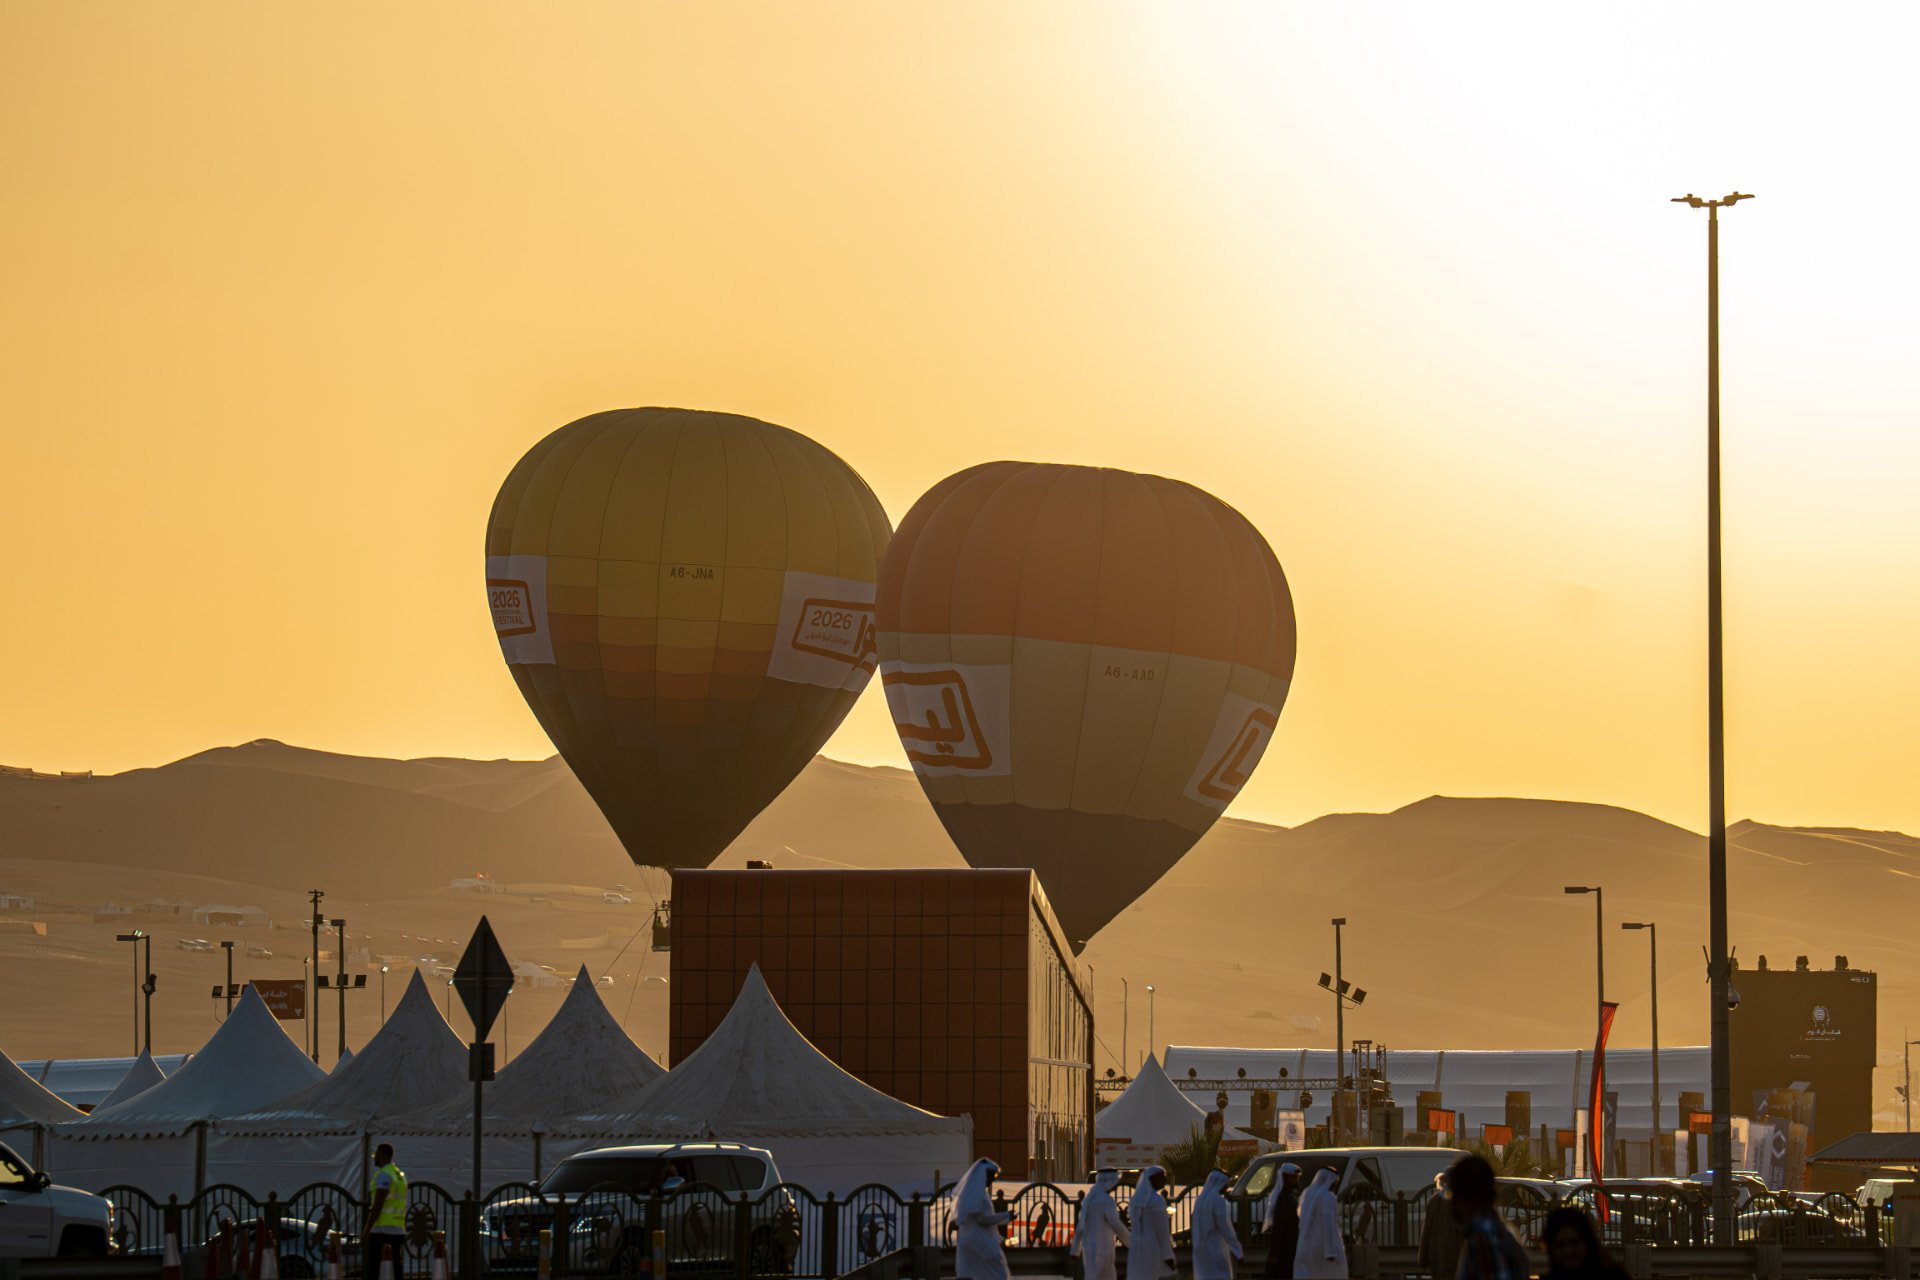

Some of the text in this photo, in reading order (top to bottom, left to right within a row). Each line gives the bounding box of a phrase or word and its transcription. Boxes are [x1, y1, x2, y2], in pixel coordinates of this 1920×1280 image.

[670, 567, 714, 580] A6-JNA
[493, 590, 520, 608] 2026
[810, 610, 852, 630] 2026
